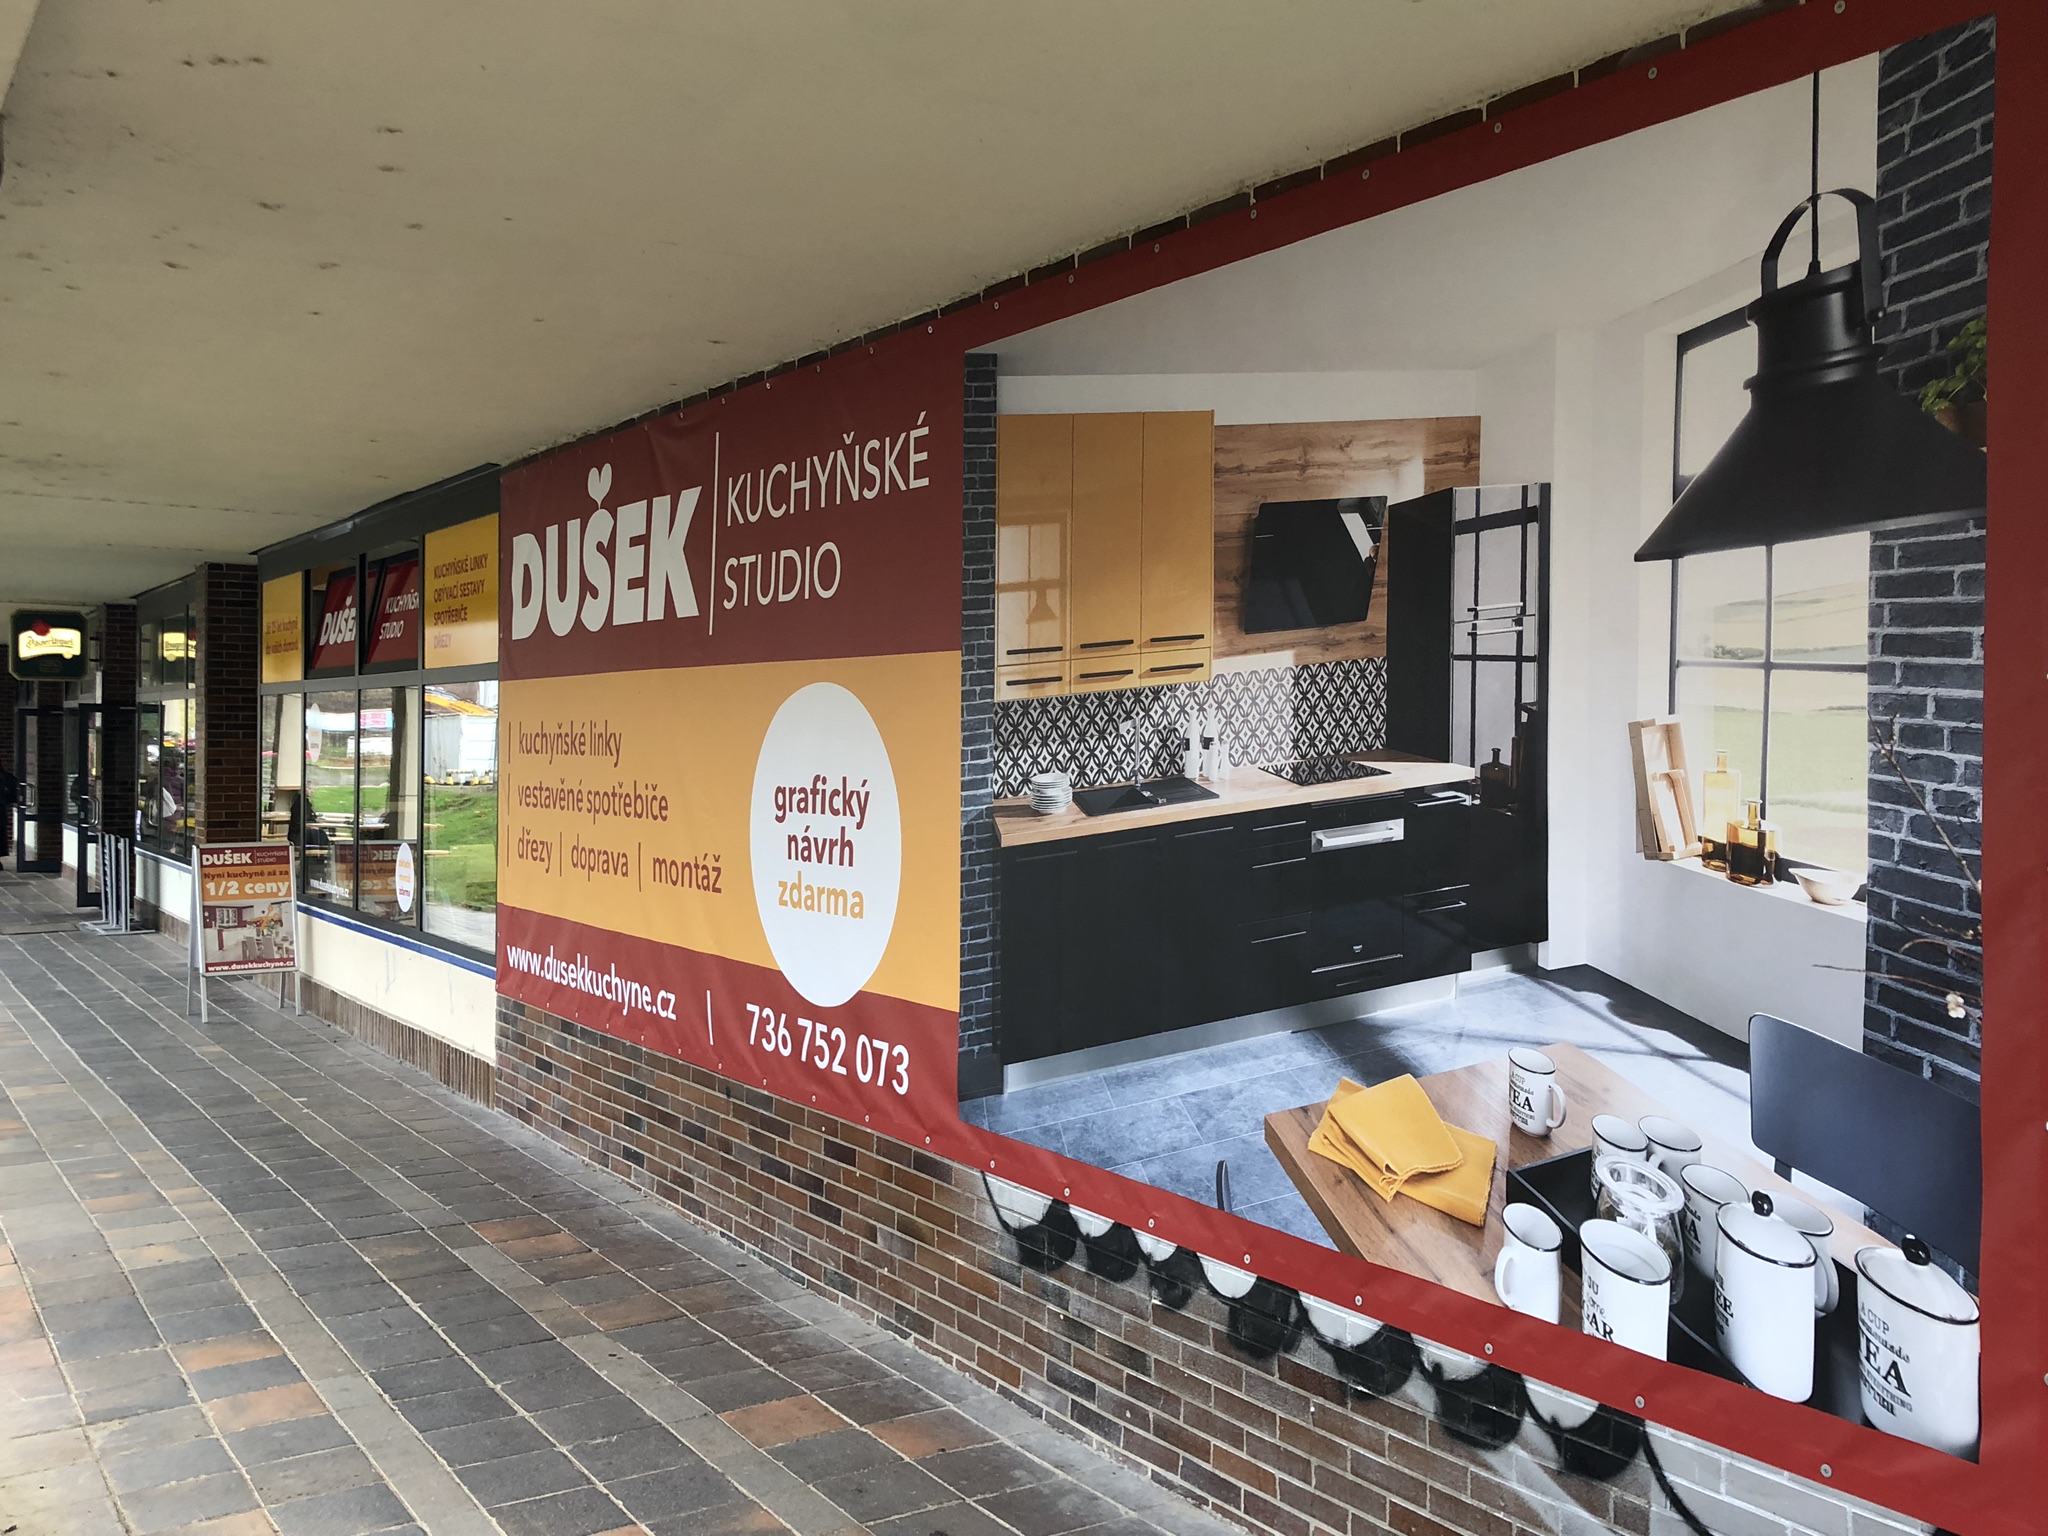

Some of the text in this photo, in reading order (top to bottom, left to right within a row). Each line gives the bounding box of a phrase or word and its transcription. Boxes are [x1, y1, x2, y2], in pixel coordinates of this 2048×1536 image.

[727, 411, 930, 527] KUCHYŇSKÉ
[433, 553, 488, 580] KUCHYŇSKÉ LINKY
[511, 463, 702, 640] DUŠEK
[433, 579, 486, 603] OBÝVACÍ SESTAVY
[723, 542, 842, 610] STUDIO
[379, 620, 404, 640] STUDIO
[518, 719, 622, 768] kuchyňské linky
[517, 778, 669, 825] vestavěné spotřebiče
[774, 774, 870, 830] grafický
[202, 850, 253, 866] DUŠEK
[517, 827, 723, 894] dřezy doprava montáž
[787, 827, 855, 867] návrh
[206, 881, 290, 897] 1/2 ceny
[267, 869, 277, 877] až
[778, 871, 865, 920] zdarma
[207, 960, 294, 972] www.dusekkuchyne.cz
[507, 944, 677, 1021] www.dusekkuchyne.cz
[746, 1003, 910, 1096] 736 752 073
[1867, 1309, 1890, 1335] CUP
